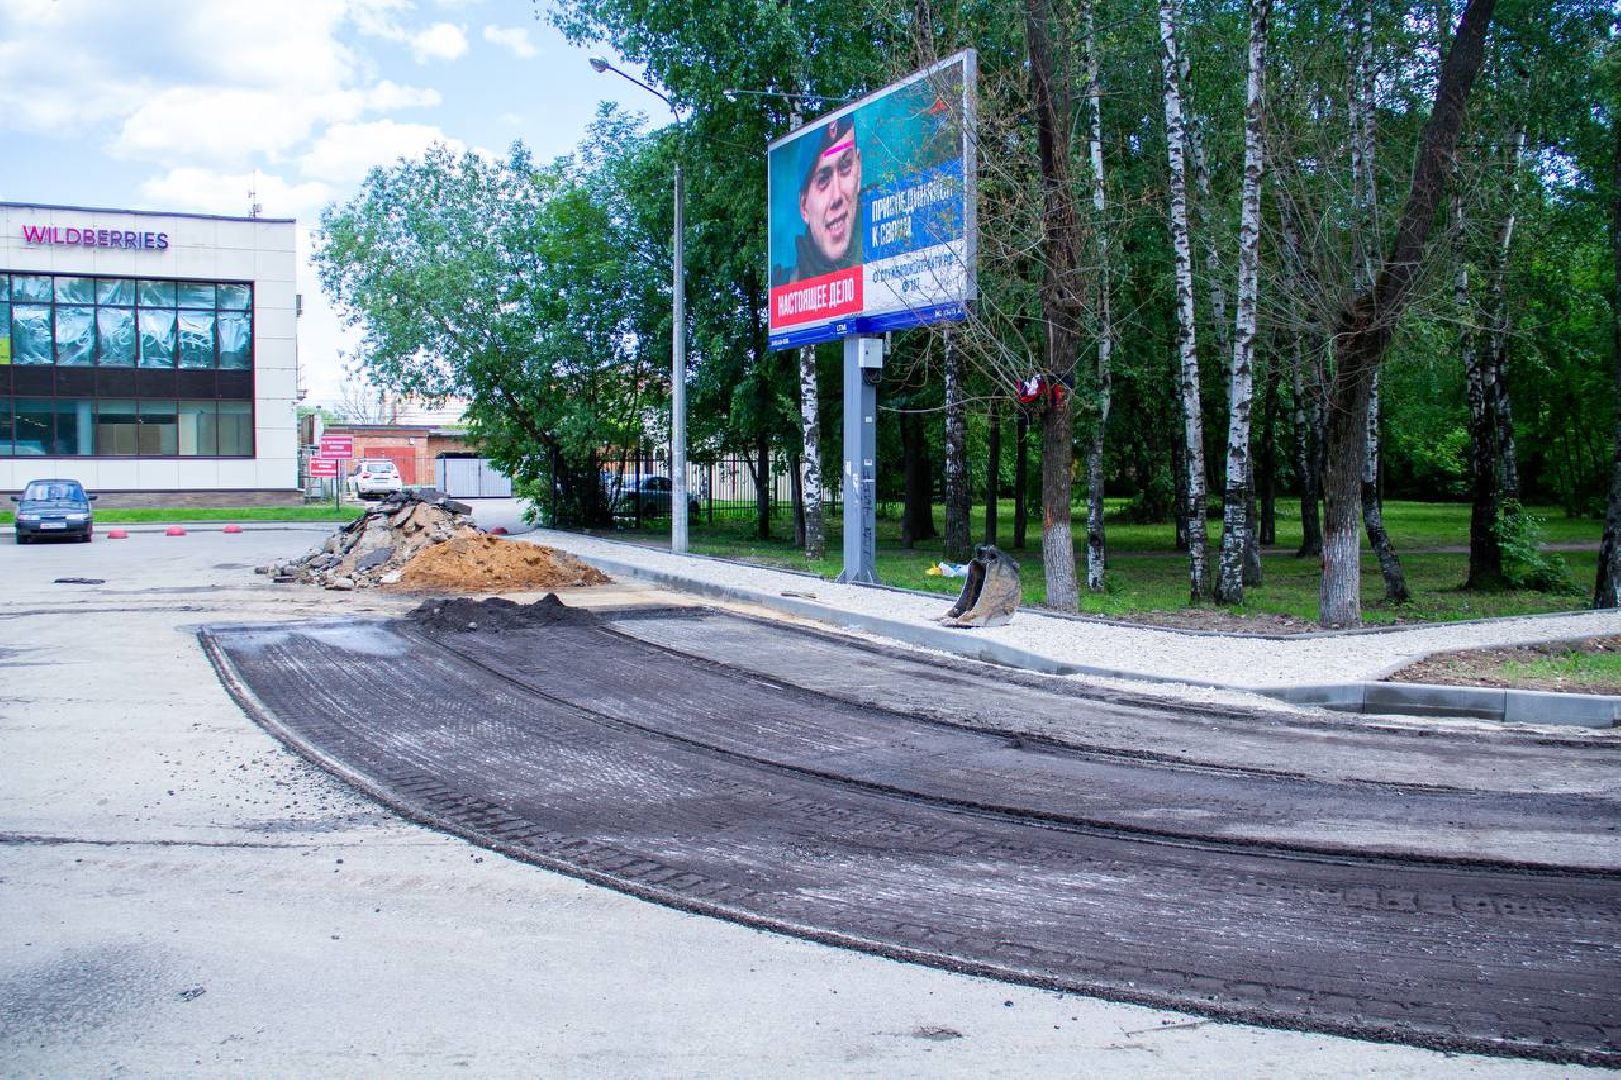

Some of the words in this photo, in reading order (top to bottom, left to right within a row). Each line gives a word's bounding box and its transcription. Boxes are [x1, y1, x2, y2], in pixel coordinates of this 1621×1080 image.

[22, 224, 169, 250] WILDBERRIES
[871, 225, 879, 248] К
[777, 284, 827, 318] НАСТОЯЩЕЕ
[828, 277, 854, 309] ДЕЛО
